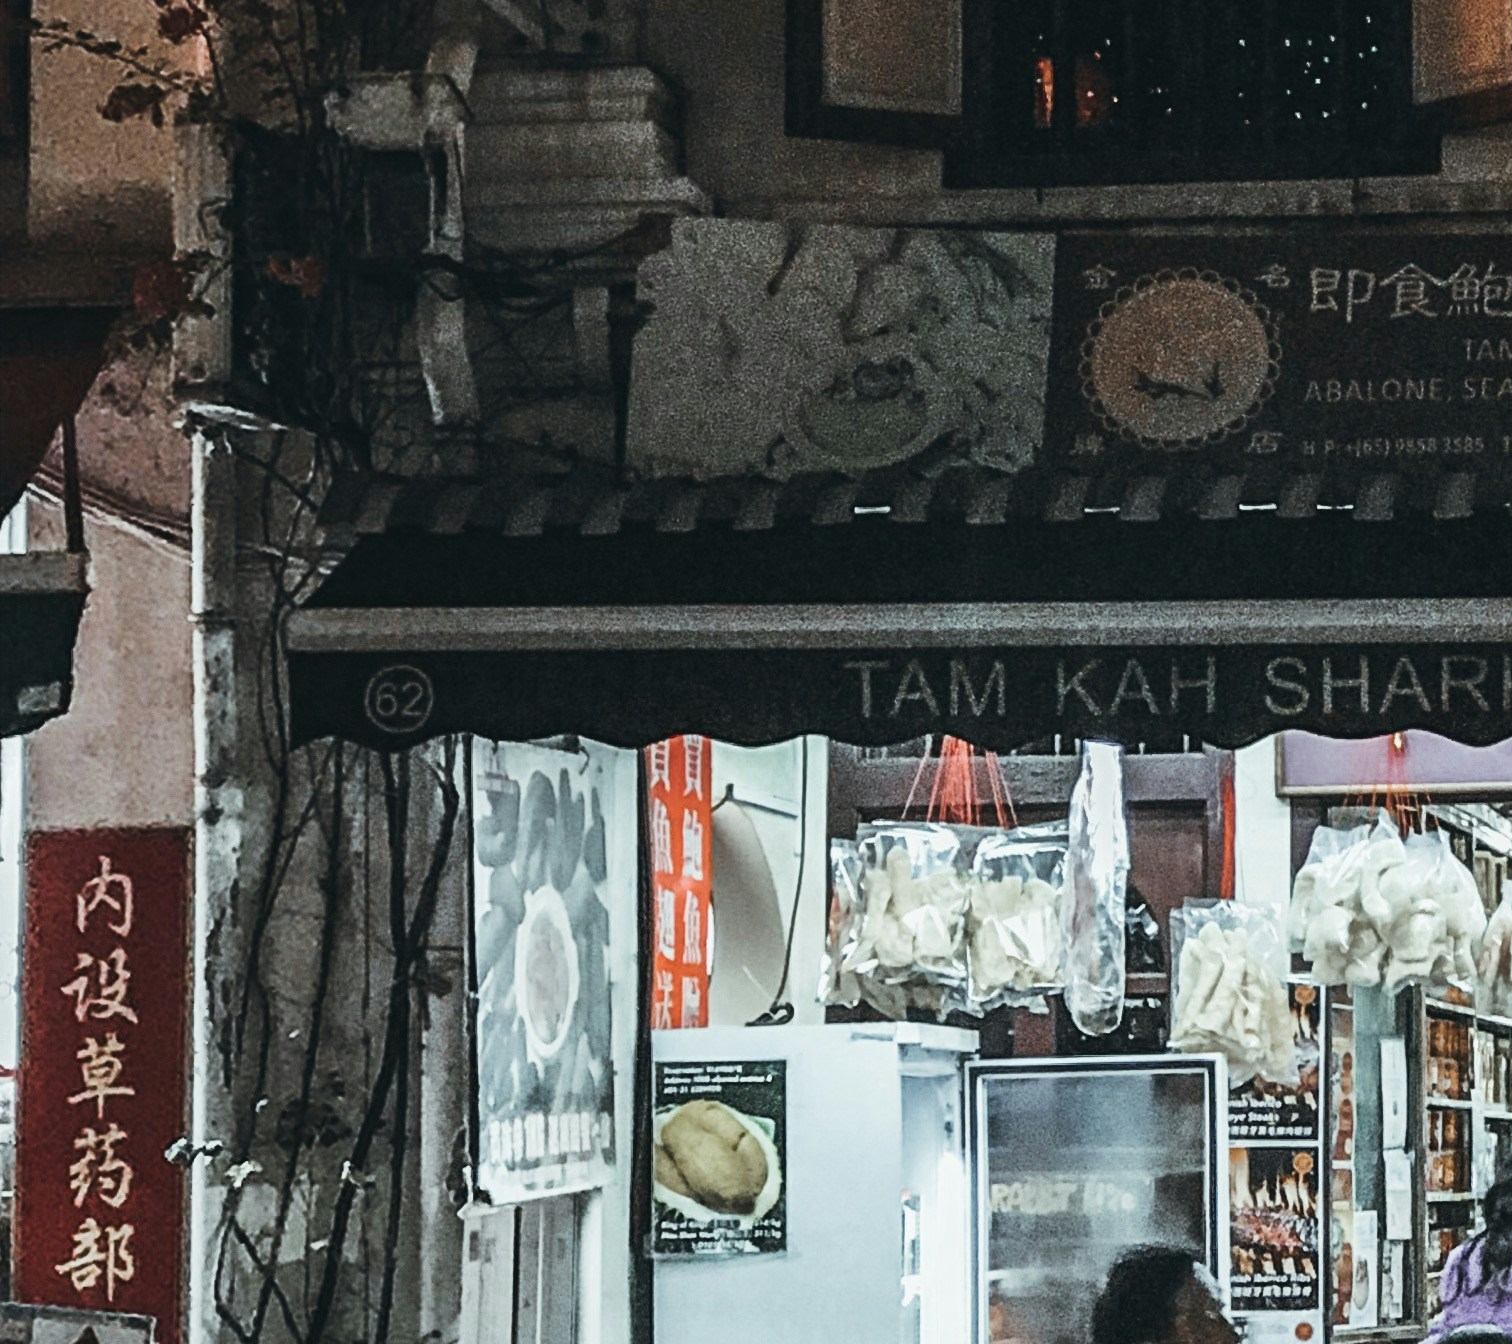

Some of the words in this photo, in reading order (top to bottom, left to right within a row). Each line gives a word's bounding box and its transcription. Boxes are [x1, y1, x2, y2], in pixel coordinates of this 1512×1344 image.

[1304, 378, 1453, 405] ABALONE,
[374, 681, 424, 716] 62
[842, 659, 1004, 719] TAM
[1054, 658, 1218, 717] KAH
